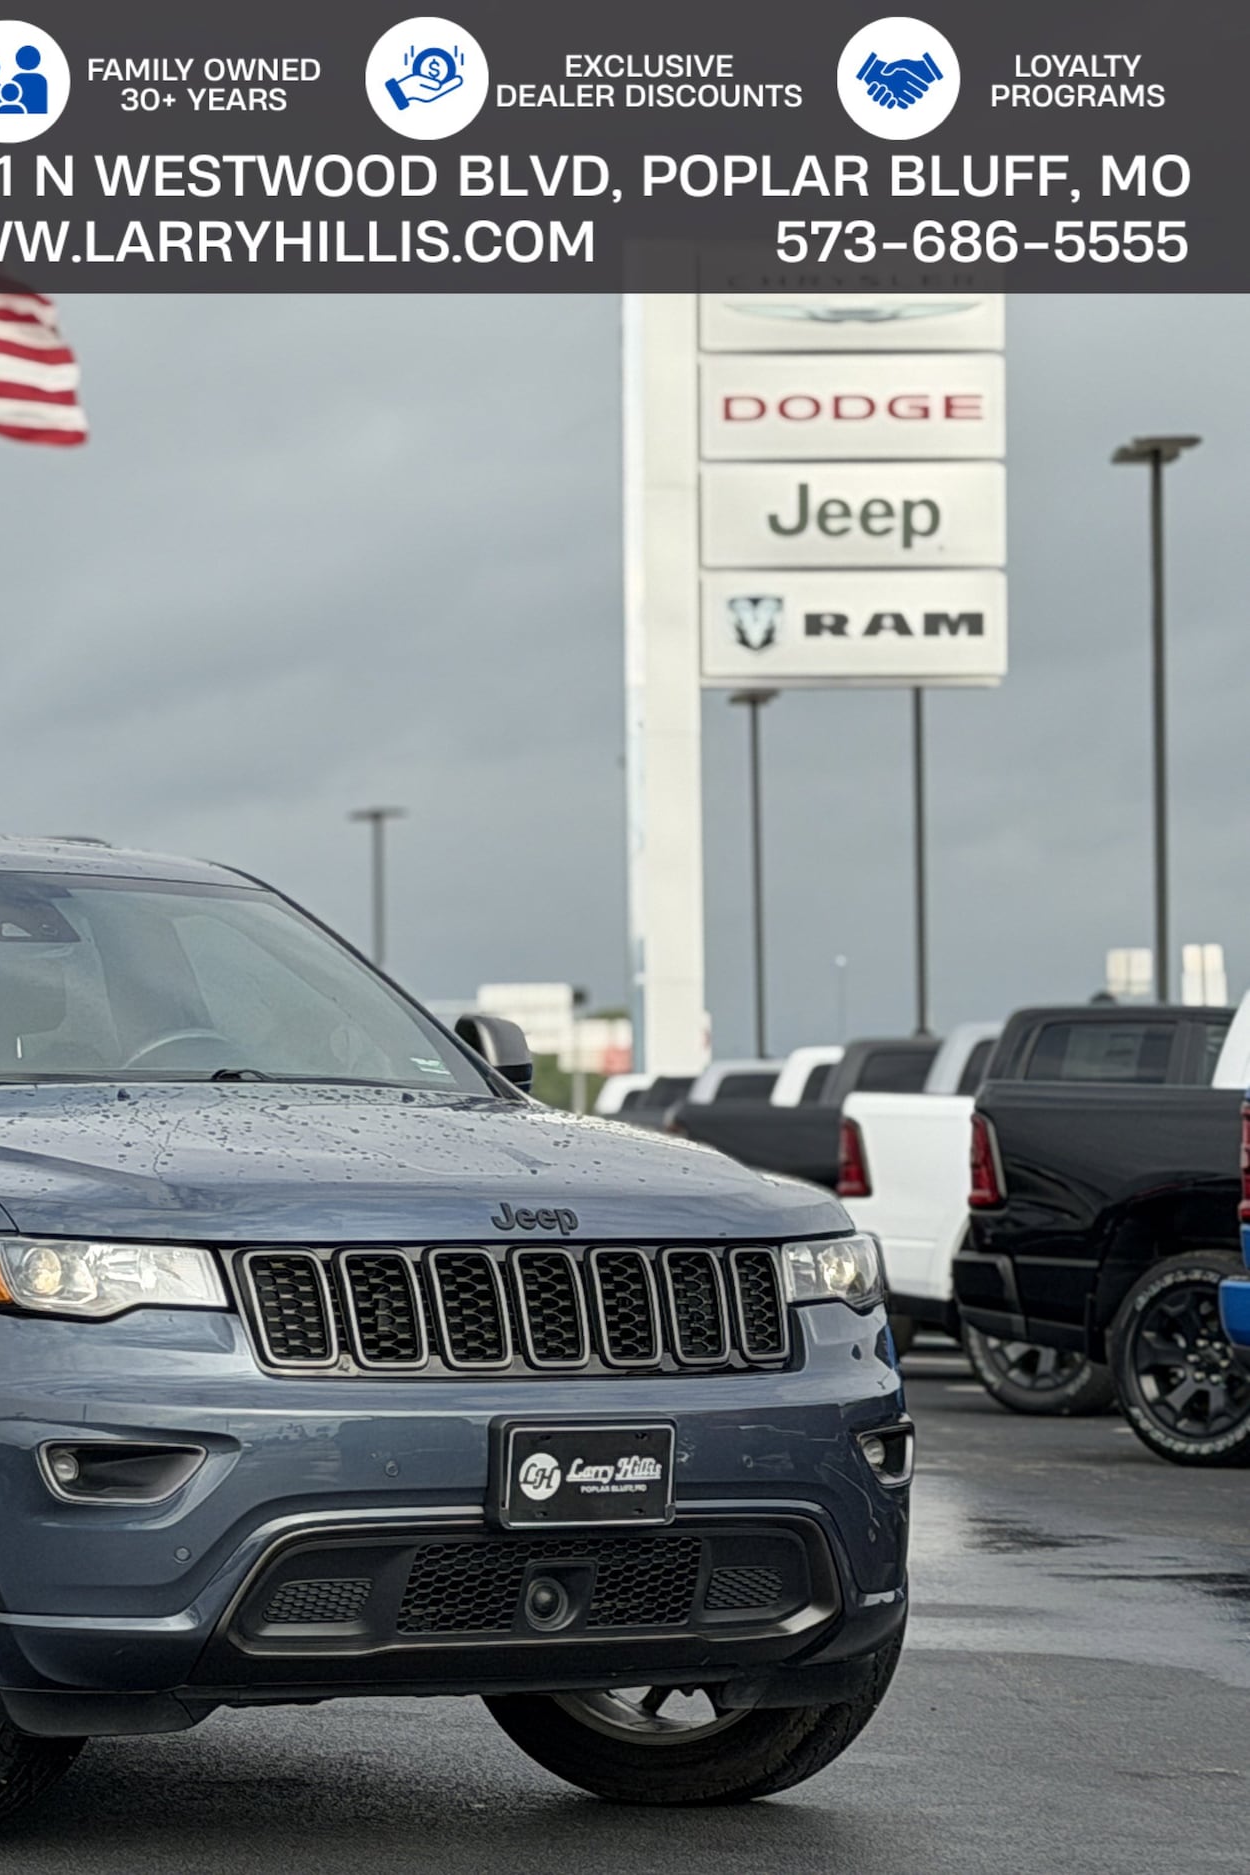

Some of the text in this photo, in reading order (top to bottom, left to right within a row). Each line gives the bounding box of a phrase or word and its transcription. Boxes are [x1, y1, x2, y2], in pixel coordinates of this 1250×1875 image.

[723, 394, 984, 421] DODGE
[767, 483, 941, 550] Jeep
[804, 612, 985, 637] RAM
[491, 1202, 579, 1236] Jeep
[566, 1455, 662, 1484] Larry Hillis
